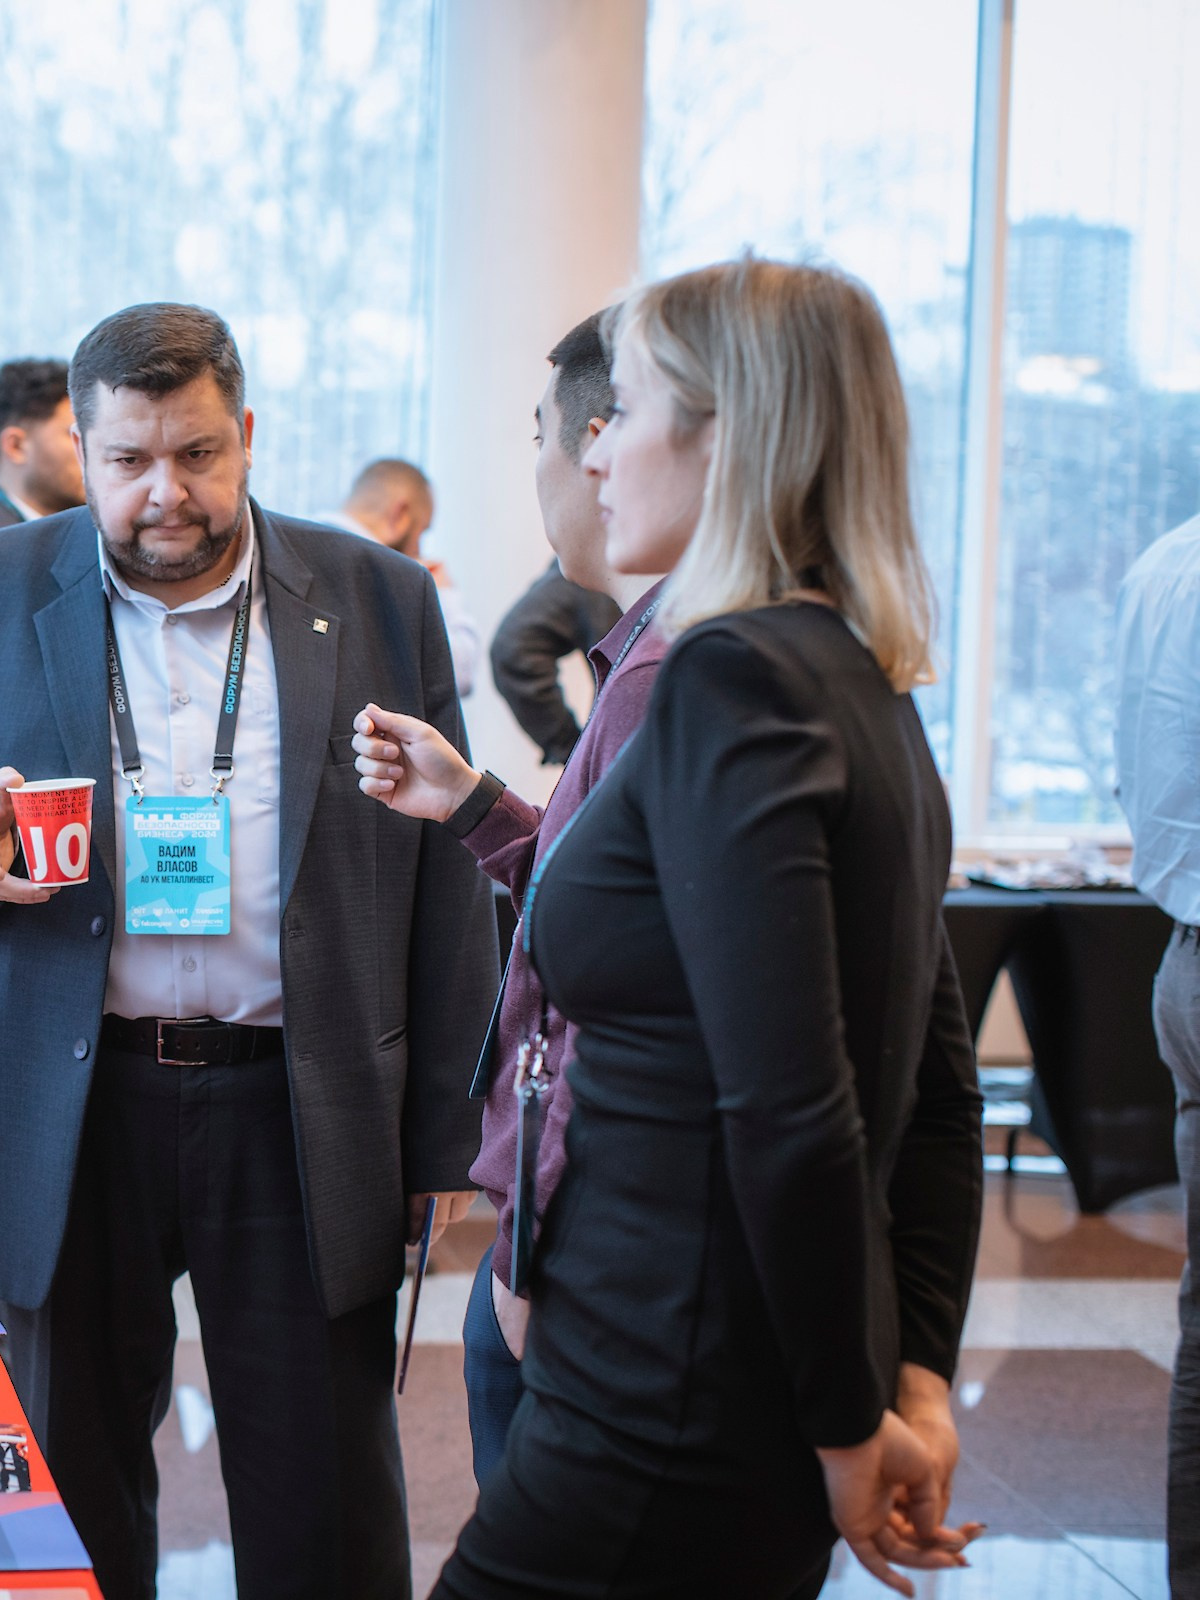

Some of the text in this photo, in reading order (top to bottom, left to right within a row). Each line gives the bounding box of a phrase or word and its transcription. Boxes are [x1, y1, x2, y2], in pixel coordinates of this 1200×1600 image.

[112, 675, 126, 713] ФОРУМ
[225, 674, 238, 714] ФОРУМ
[180, 812, 217, 820] ФОРУМ
[158, 845, 196, 858] ВАДИМ
[157, 861, 198, 872] ВЛАСОВ
[140, 875, 215, 884] АО УК МЕТАЛЛИНВЕСТ
